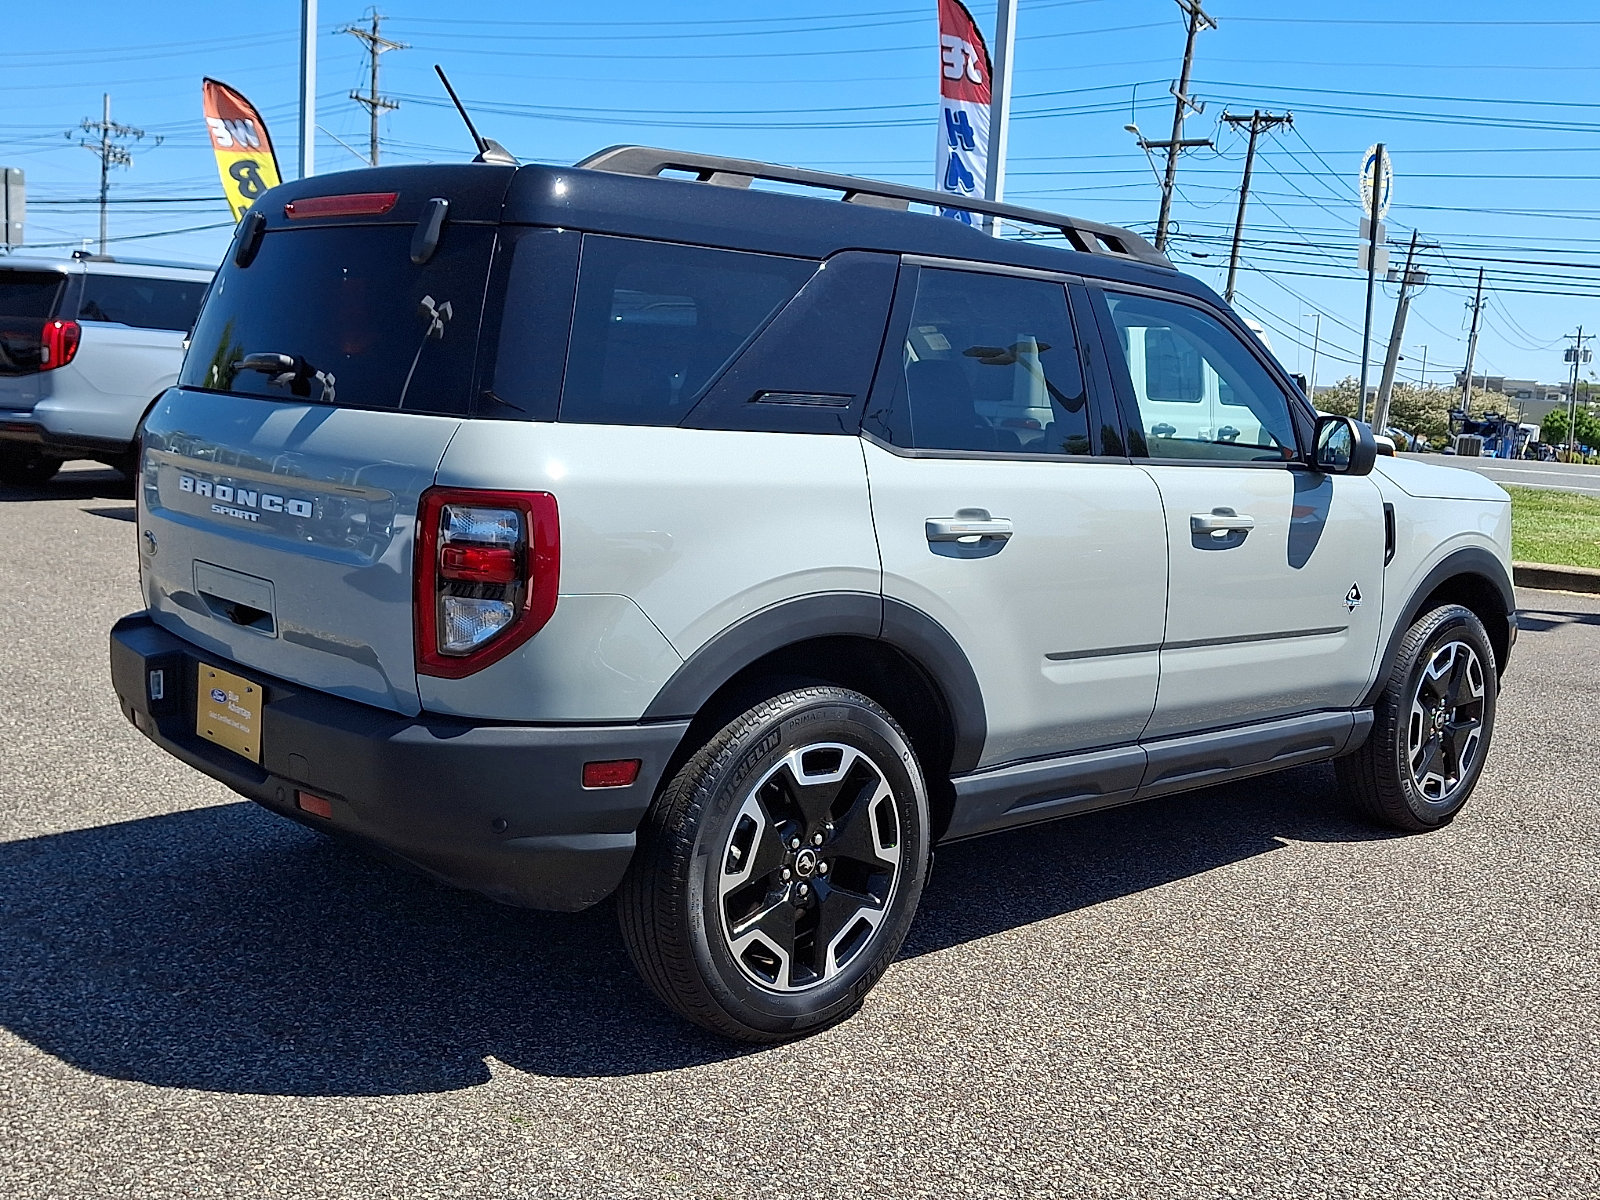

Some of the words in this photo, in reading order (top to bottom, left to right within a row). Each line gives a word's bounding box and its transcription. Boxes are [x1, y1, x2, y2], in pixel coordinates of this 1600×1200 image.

[179, 475, 313, 518] BRONCO
[211, 503, 260, 521] SPORT
[718, 729, 781, 812] MICHELIN
